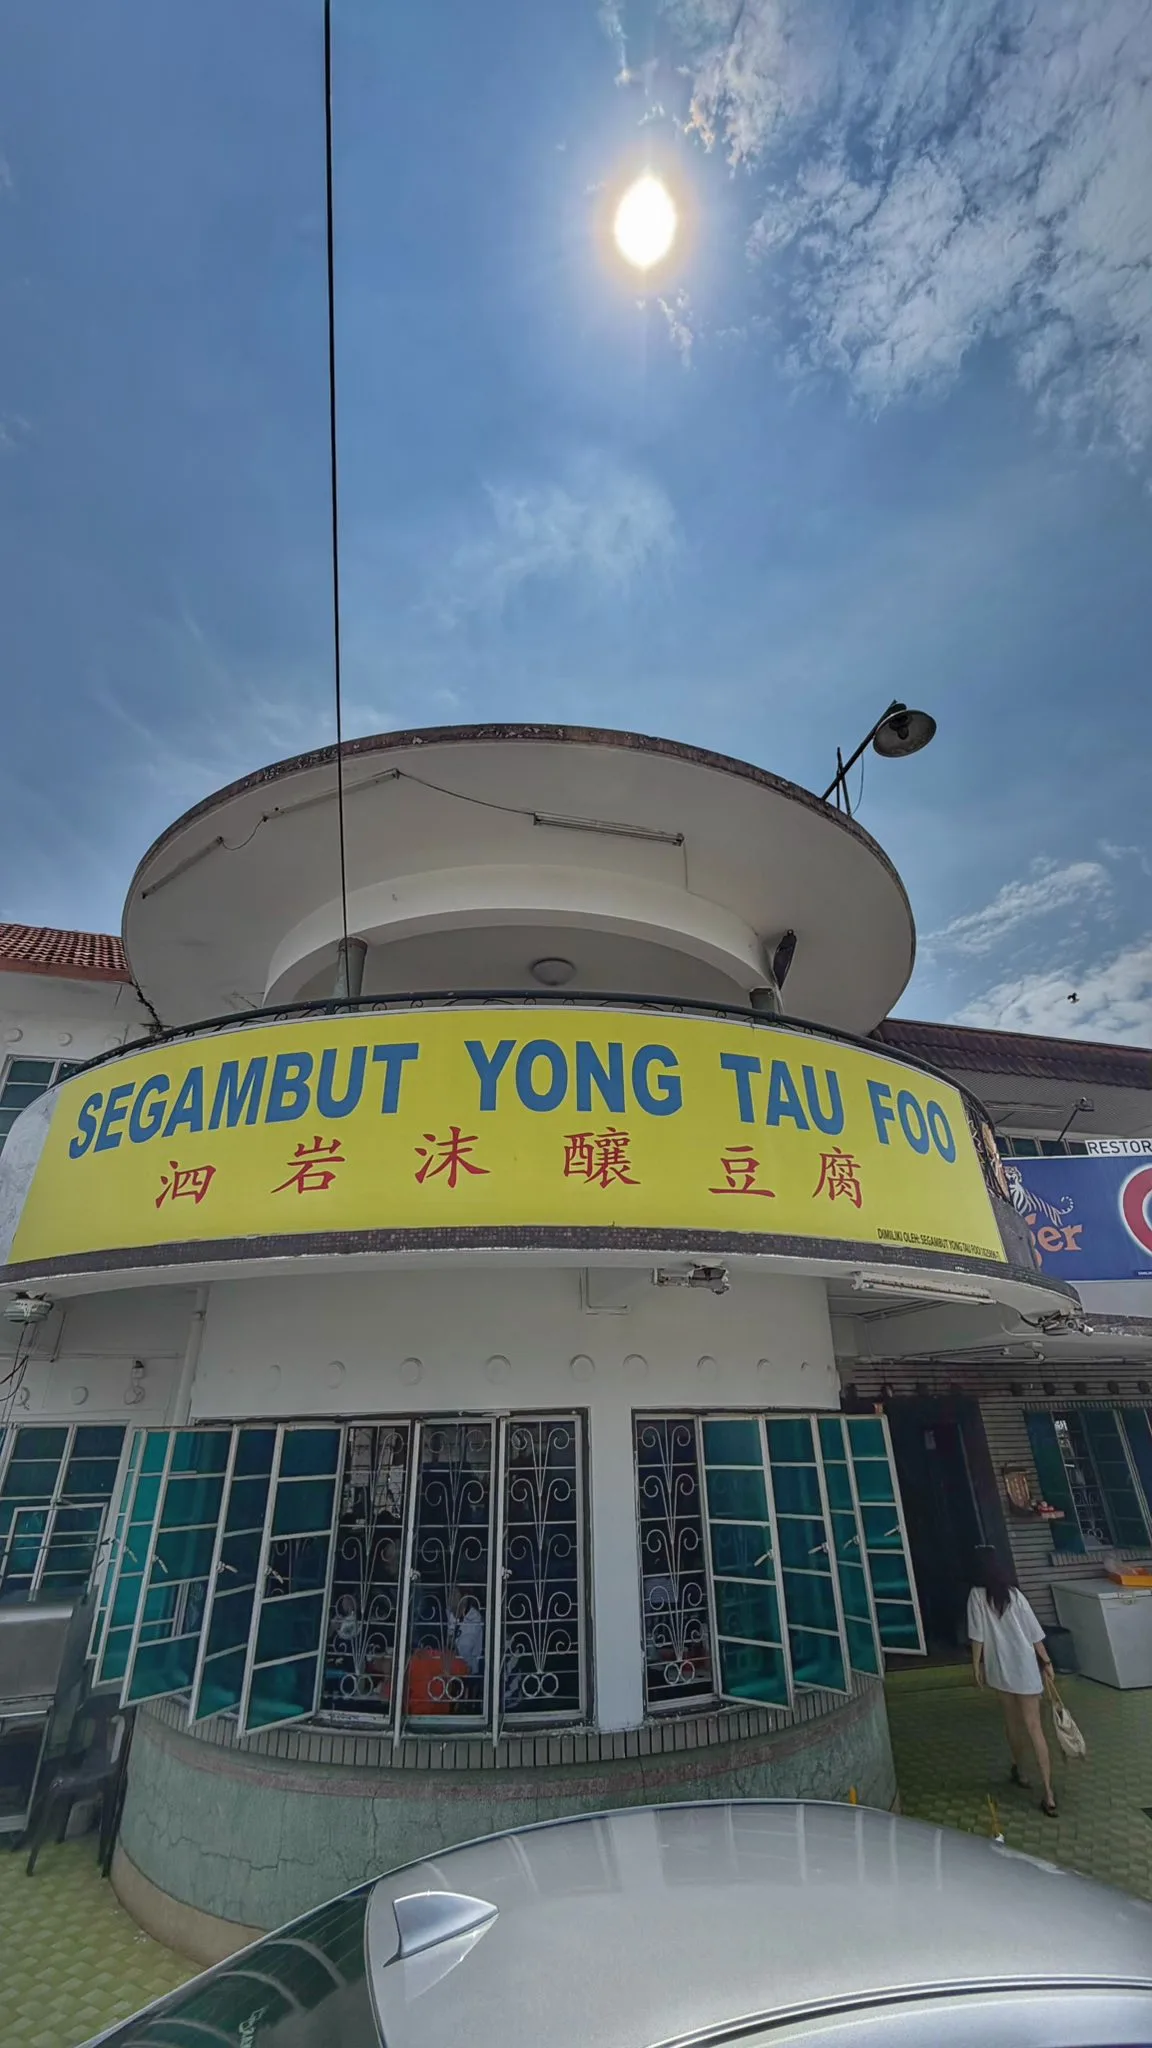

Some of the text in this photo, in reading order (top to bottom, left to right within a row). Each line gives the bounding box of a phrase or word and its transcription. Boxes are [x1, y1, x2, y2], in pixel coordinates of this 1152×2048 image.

[69, 1039, 957, 1164] SEGAMBUT YONG TAU FOO
